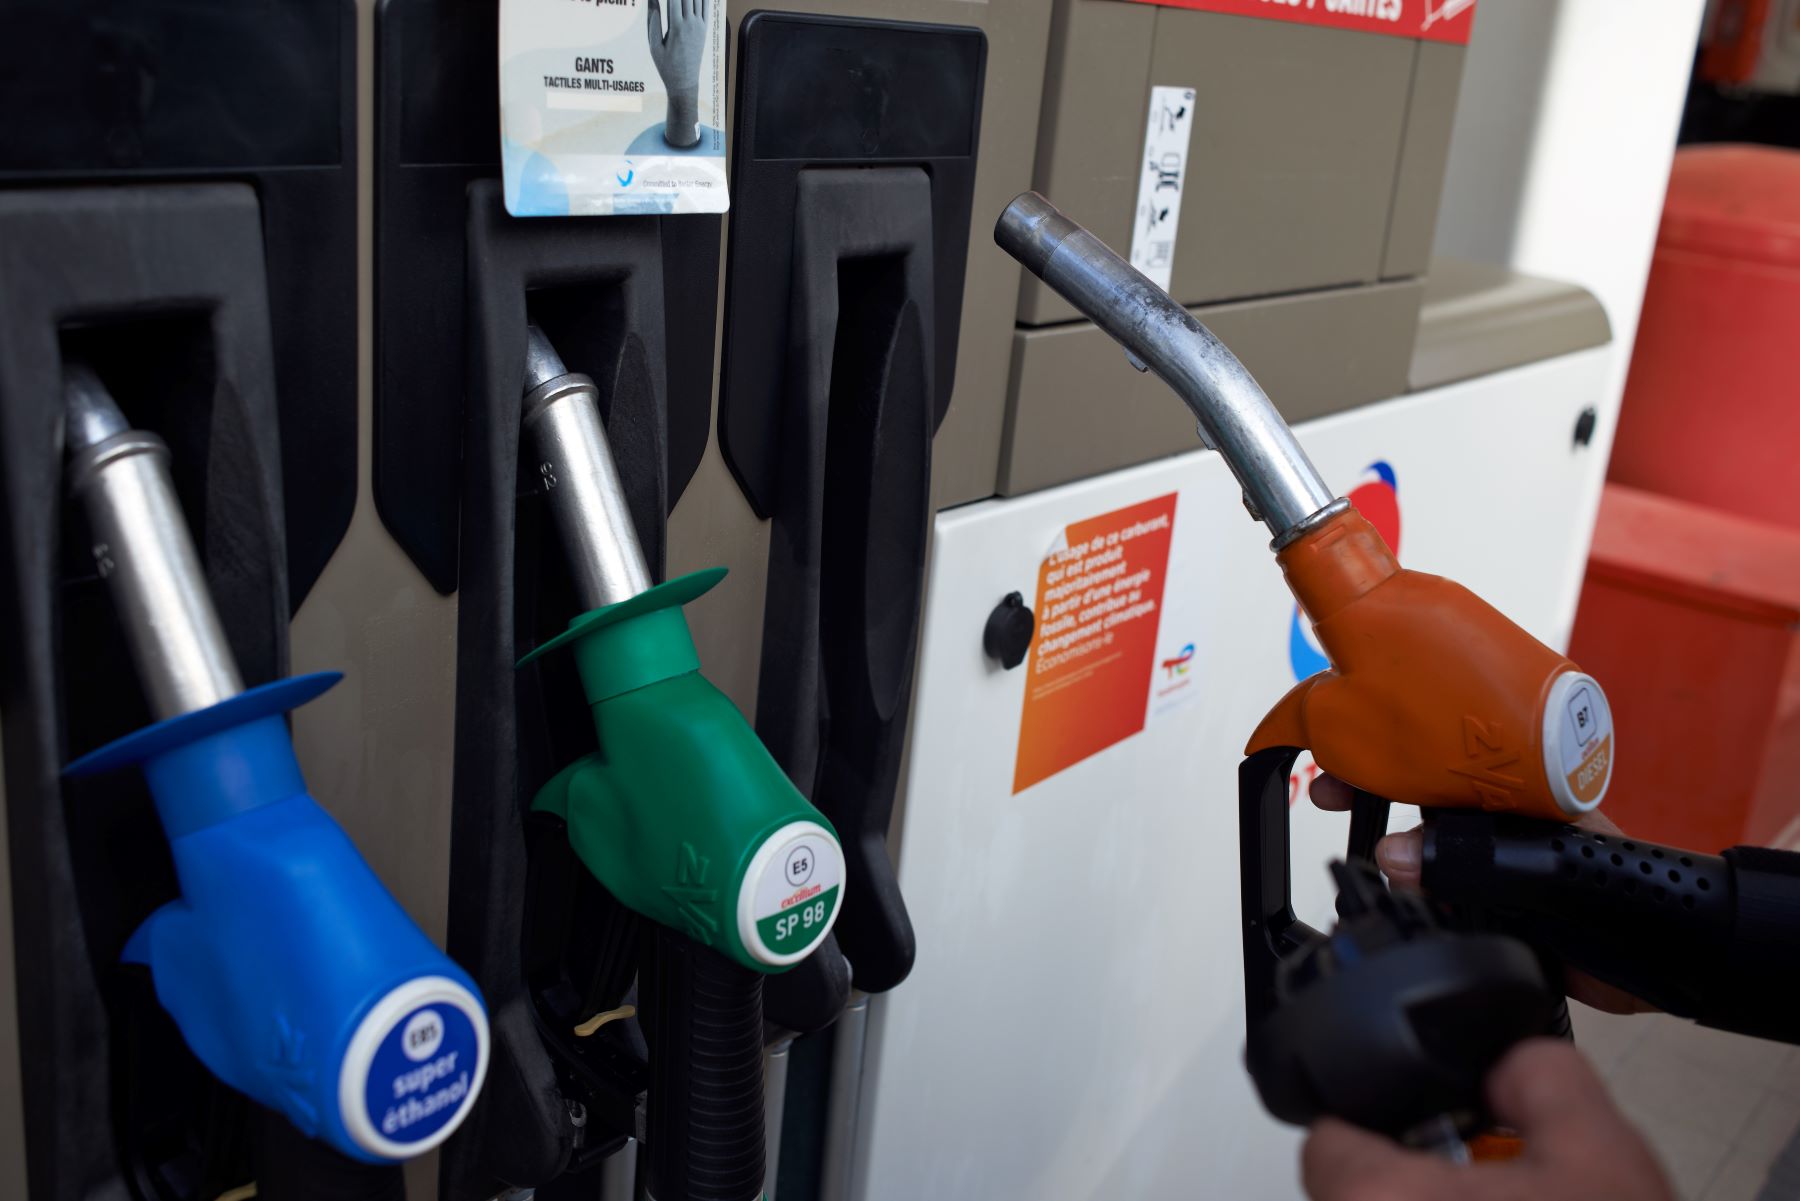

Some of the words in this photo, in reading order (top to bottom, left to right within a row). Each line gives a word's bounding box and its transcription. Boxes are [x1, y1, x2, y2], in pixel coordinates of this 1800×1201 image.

[544, 76, 582, 89] TACTILES
[584, 78, 645, 93] MULTI-USAGES
[575, 57, 614, 75] GANTS
[1091, 535, 1105, 551] de
[1106, 531, 1119, 546] ce
[1045, 560, 1127, 602] majoritairement
[1046, 563, 1066, 584] qui
[1066, 559, 1083, 577] est
[1084, 544, 1123, 573] produit
[1051, 595, 1081, 619] partir
[1112, 568, 1151, 593] énergie
[1078, 594, 1127, 622] contribue
[1037, 618, 1102, 656] changement
[792, 857, 808, 875] E5
[780, 884, 822, 909] excellium
[775, 913, 799, 941] SP
[803, 901, 825, 929] 98
[392, 1050, 459, 1099] super
[381, 1070, 469, 1134] éthanol
